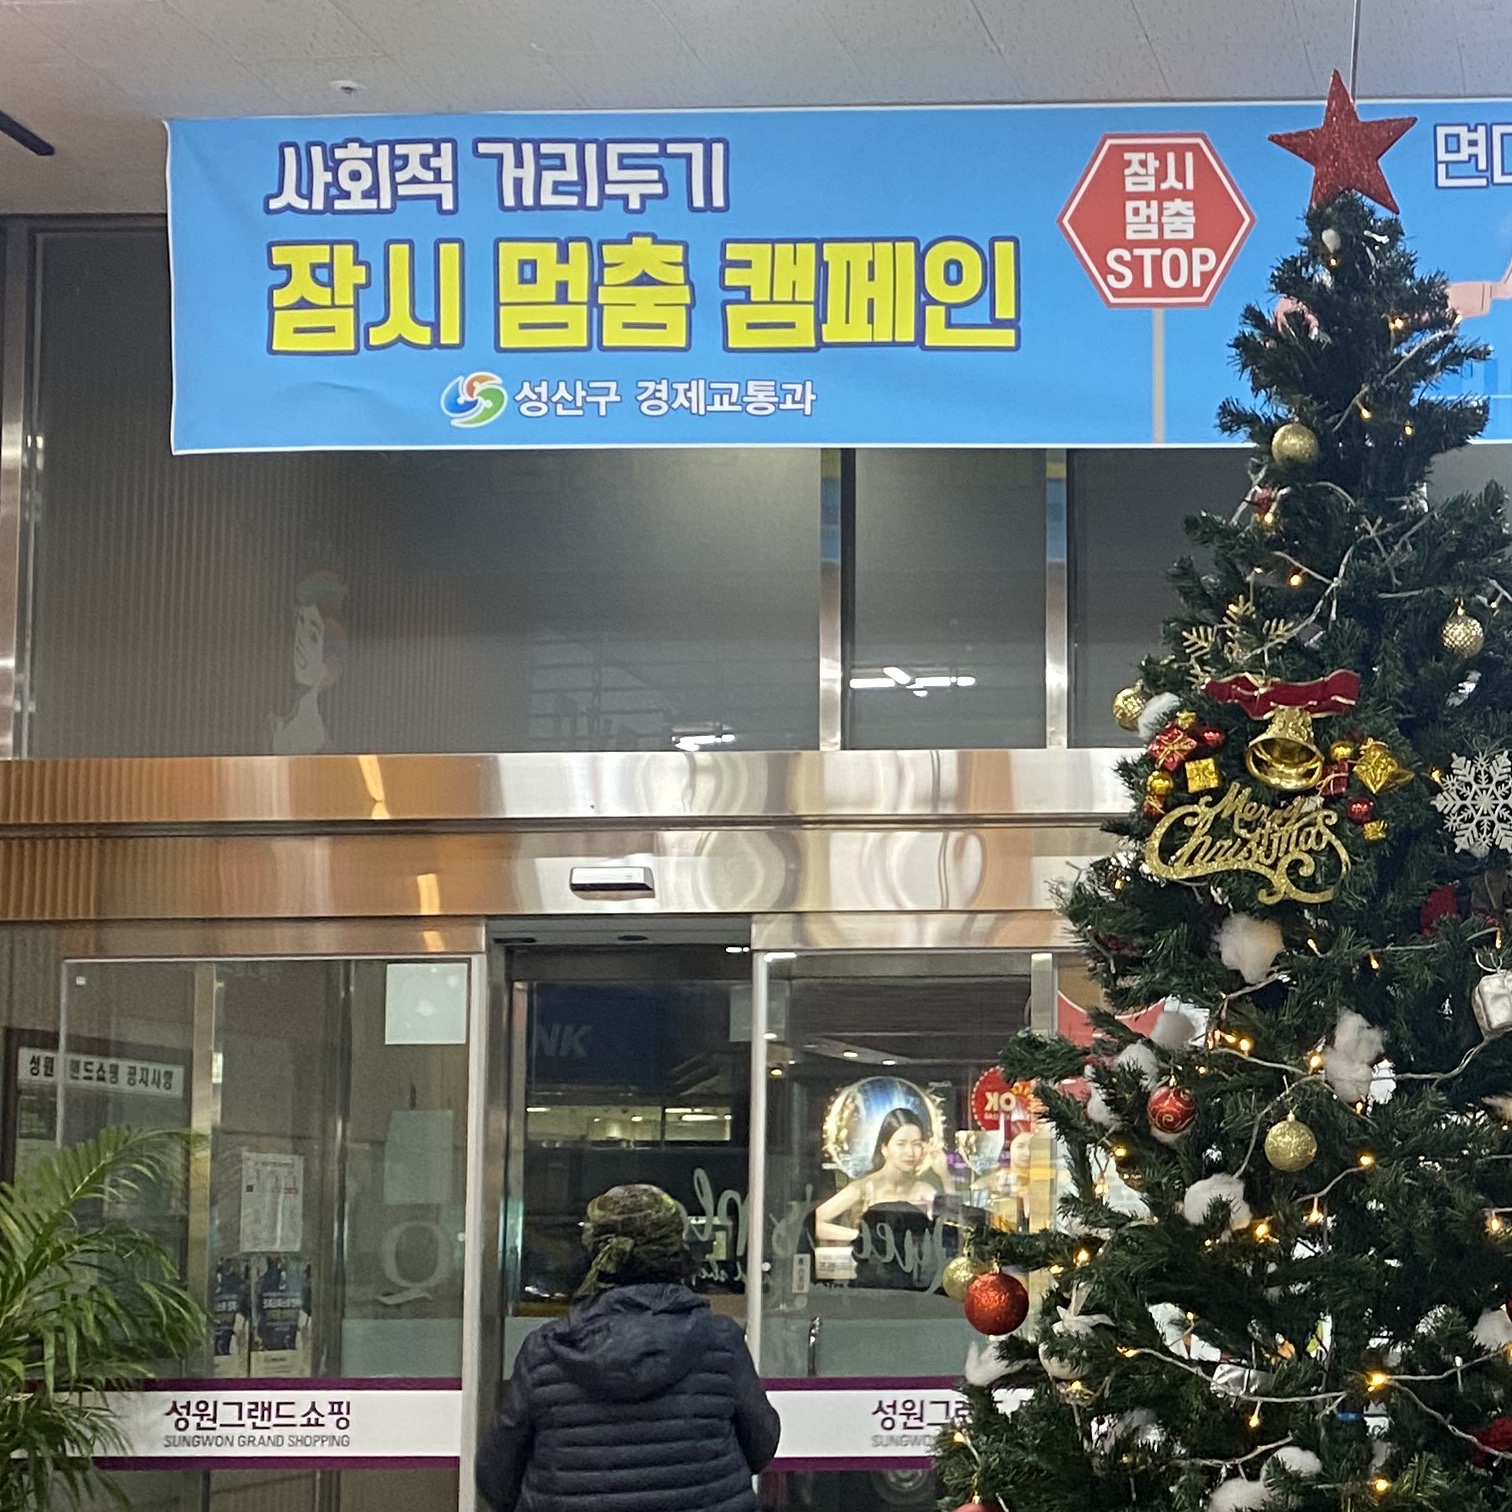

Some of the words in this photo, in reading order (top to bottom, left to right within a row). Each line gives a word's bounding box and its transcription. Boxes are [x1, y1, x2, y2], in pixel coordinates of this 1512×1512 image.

[265, 138, 459, 213] 사회적
[474, 138, 730, 212] 거리두기
[1122, 152, 1195, 192] 잠시
[1124, 201, 1195, 241] 멈춤
[1106, 247, 1217, 289] STOP
[266, 238, 464, 354] 잠시
[494, 235, 694, 352] 멈춤
[721, 237, 1020, 354] 캠페인
[514, 380, 622, 418] 성산구
[636, 380, 816, 418] 경제교통과
[1144, 806, 1351, 905] Christmas
[165, 1400, 351, 1431] 성원그랜드쇼핑
[164, 1435, 234, 1447] SUNGWON
[238, 1435, 284, 1447] GRAND
[288, 1435, 350, 1447] SHOPPING
[872, 1434, 935, 1447] SUNGWO
